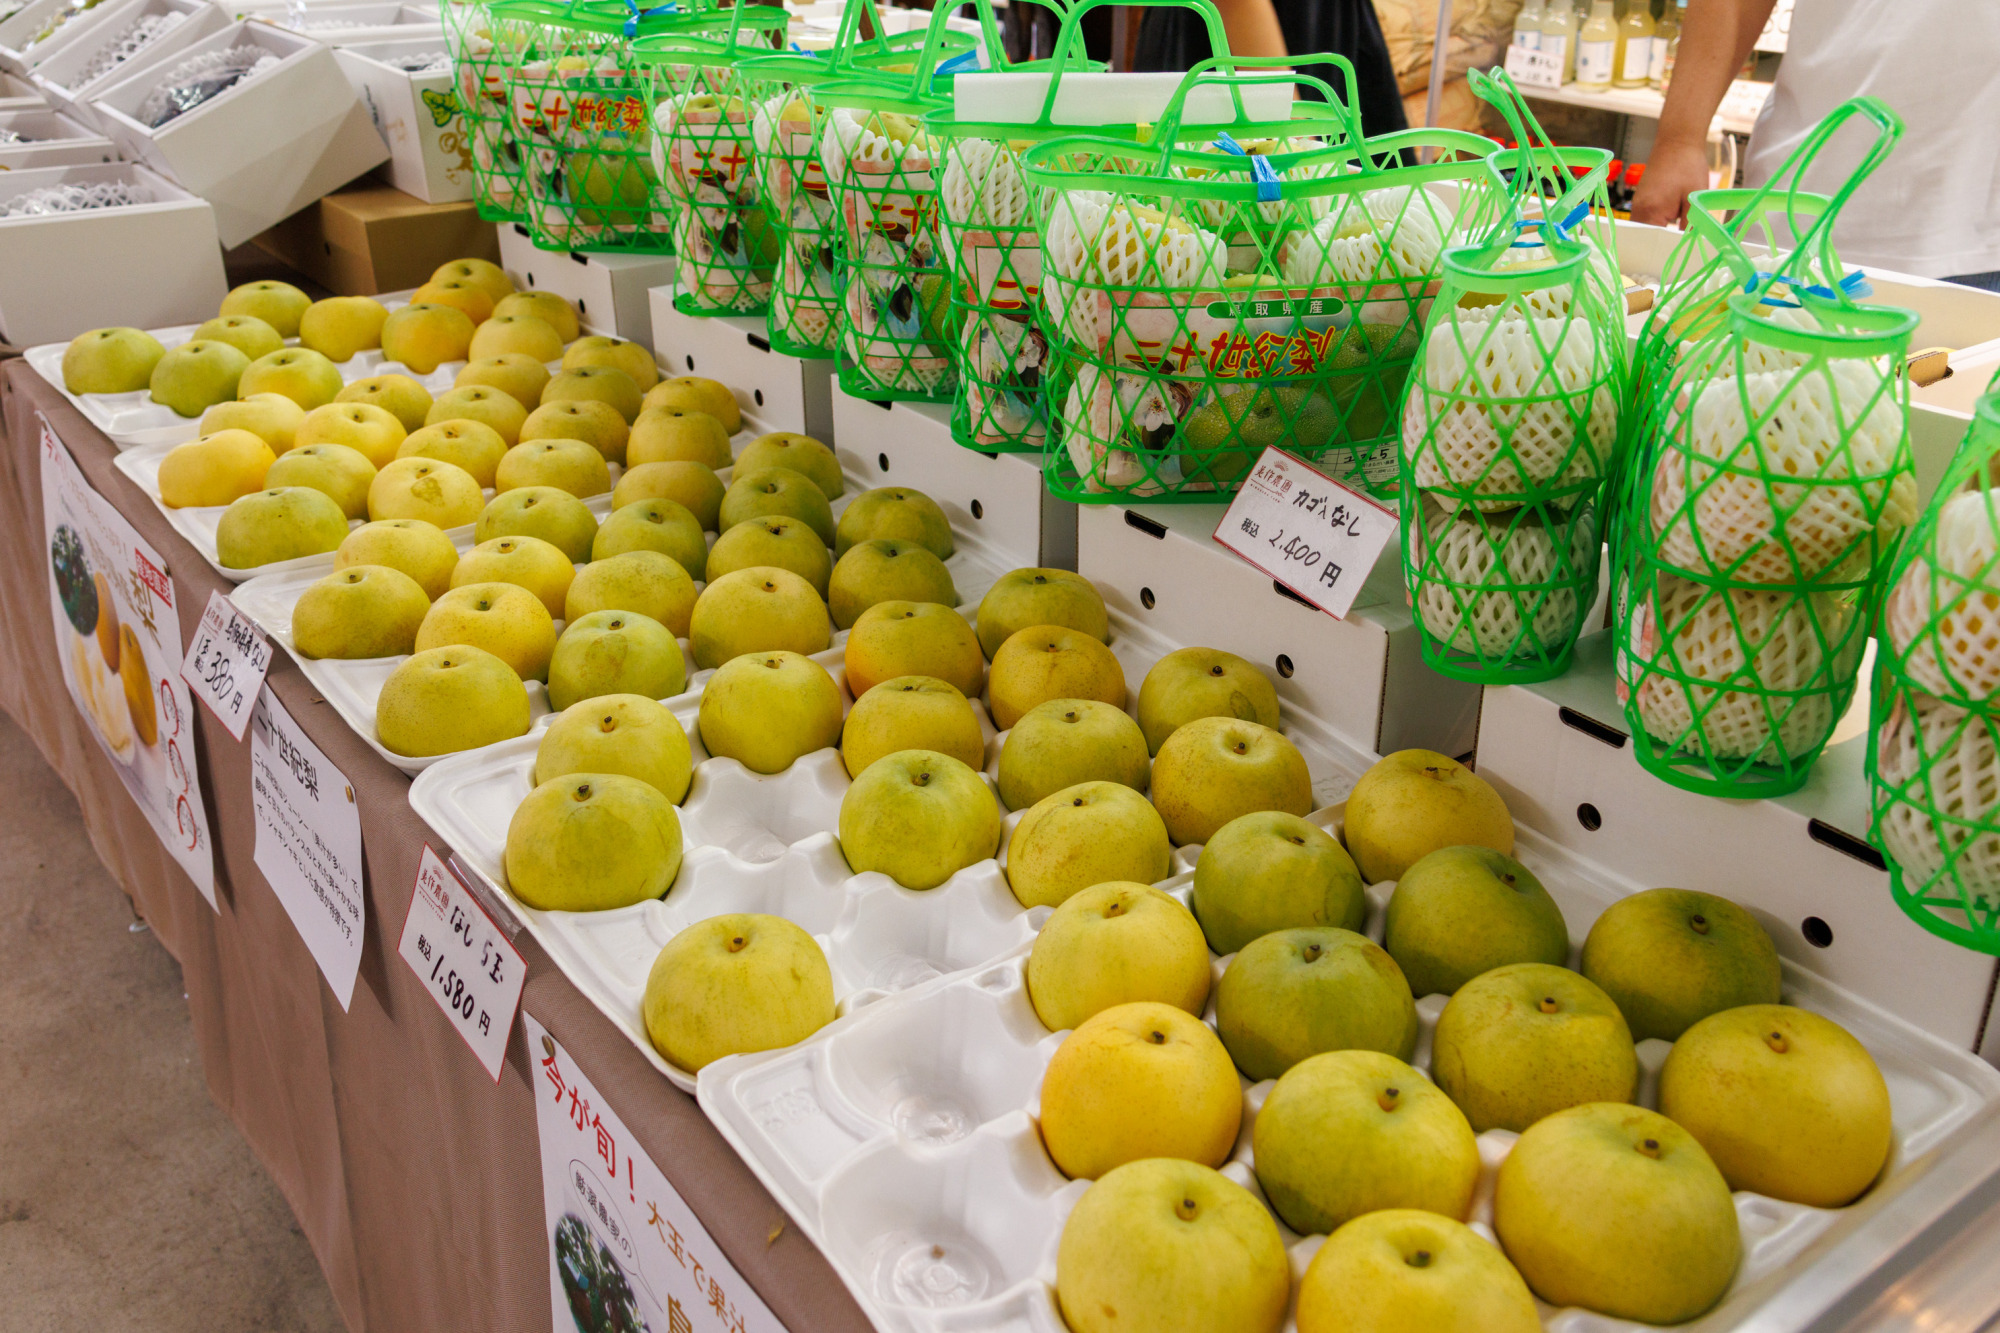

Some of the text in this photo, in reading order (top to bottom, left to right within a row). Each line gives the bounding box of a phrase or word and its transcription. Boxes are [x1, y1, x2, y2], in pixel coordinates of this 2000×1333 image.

[688, 142, 755, 182] 二十
[1229, 299, 1324, 318] 鳥取県産
[1123, 325, 1337, 380] 二十世紀梨
[1255, 465, 1293, 493] 美作農園
[1240, 517, 1260, 539] 税込
[1319, 560, 1343, 589] 円
[205, 651, 235, 700] 380
[230, 690, 243, 714] 円
[257, 696, 320, 803] 二十世紀梨
[421, 867, 450, 909] 美作農園
[449, 905, 474, 948] なし
[417, 934, 432, 962] 税込
[478, 1009, 491, 1037] 円
